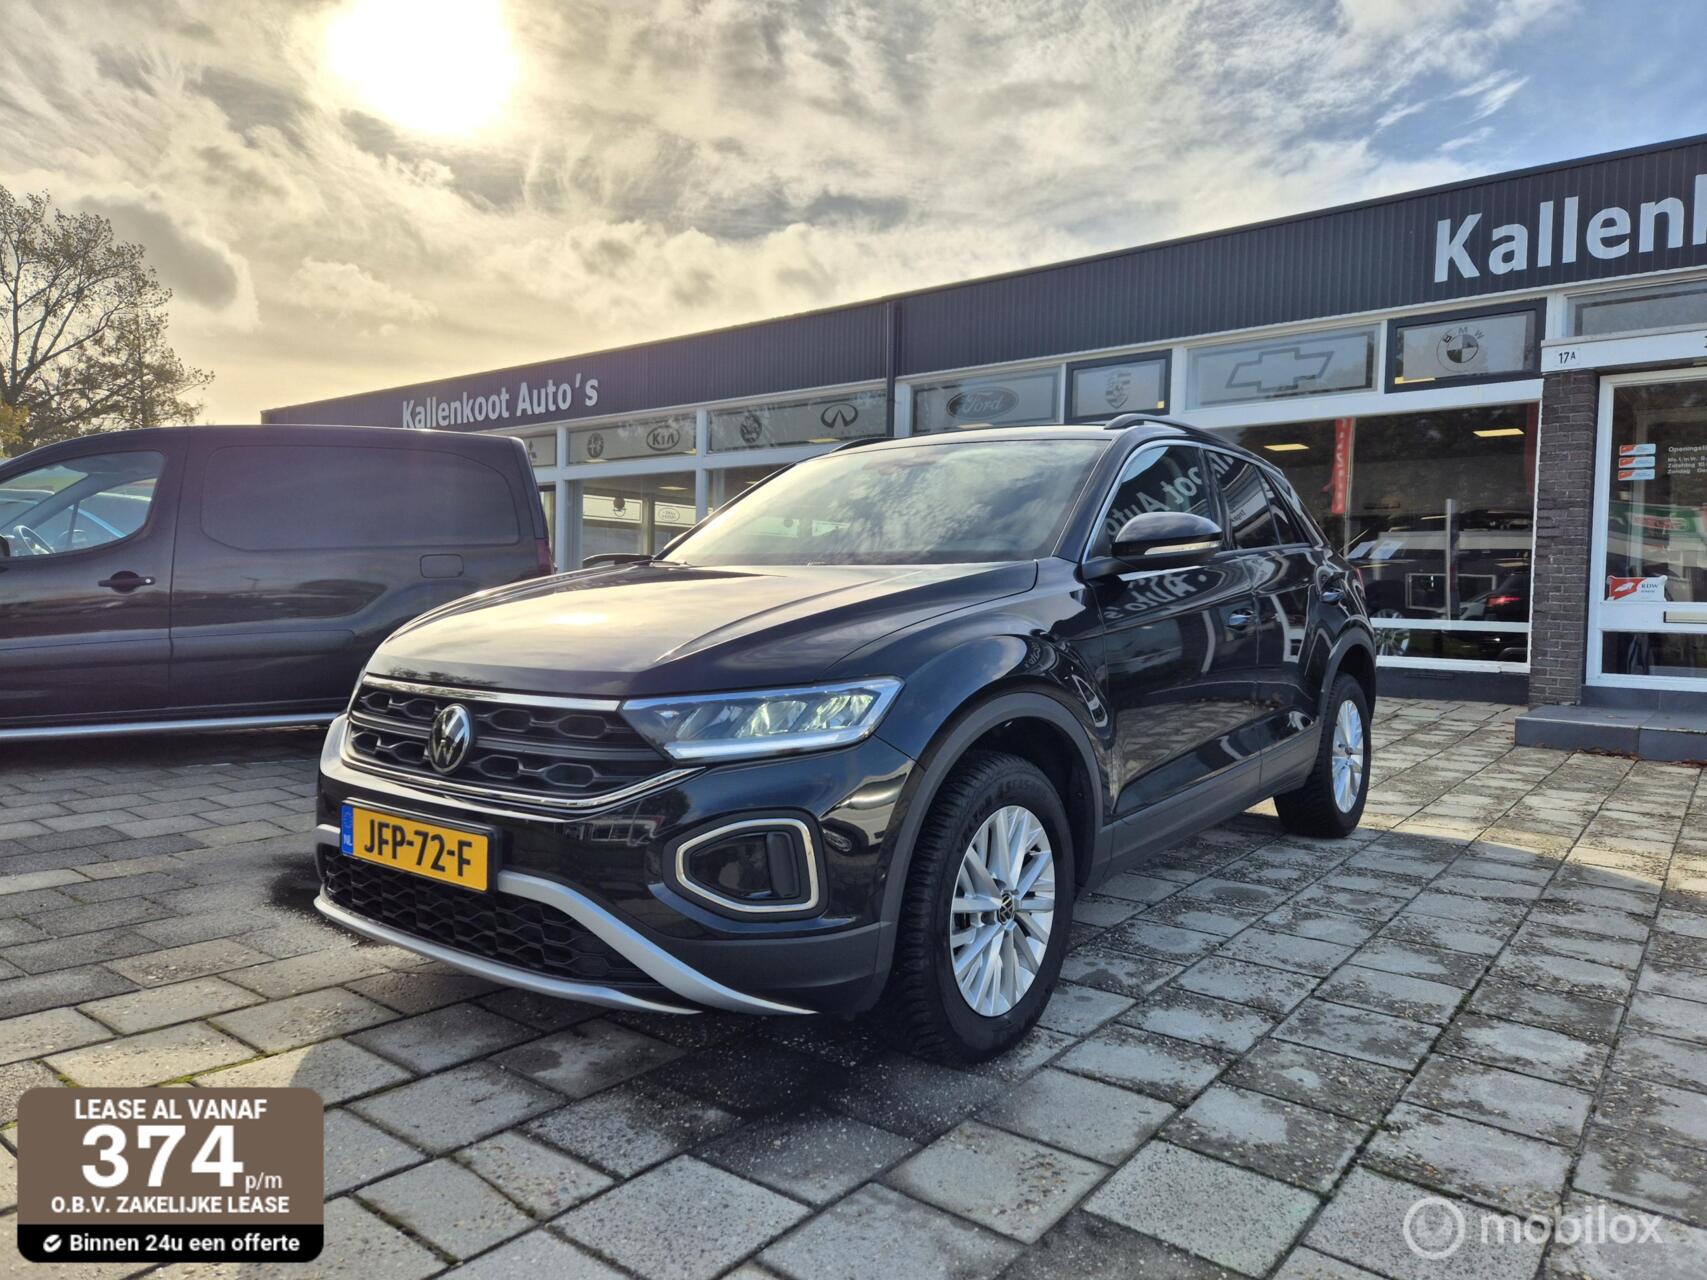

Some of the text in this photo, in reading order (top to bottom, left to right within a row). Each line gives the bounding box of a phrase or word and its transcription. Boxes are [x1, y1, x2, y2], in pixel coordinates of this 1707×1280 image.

[402, 373, 599, 429] Kallenkoot Auto's
[961, 391, 1005, 414] Ford
[343, 833, 353, 846] NL
[364, 818, 473, 877] JFP-72-F
